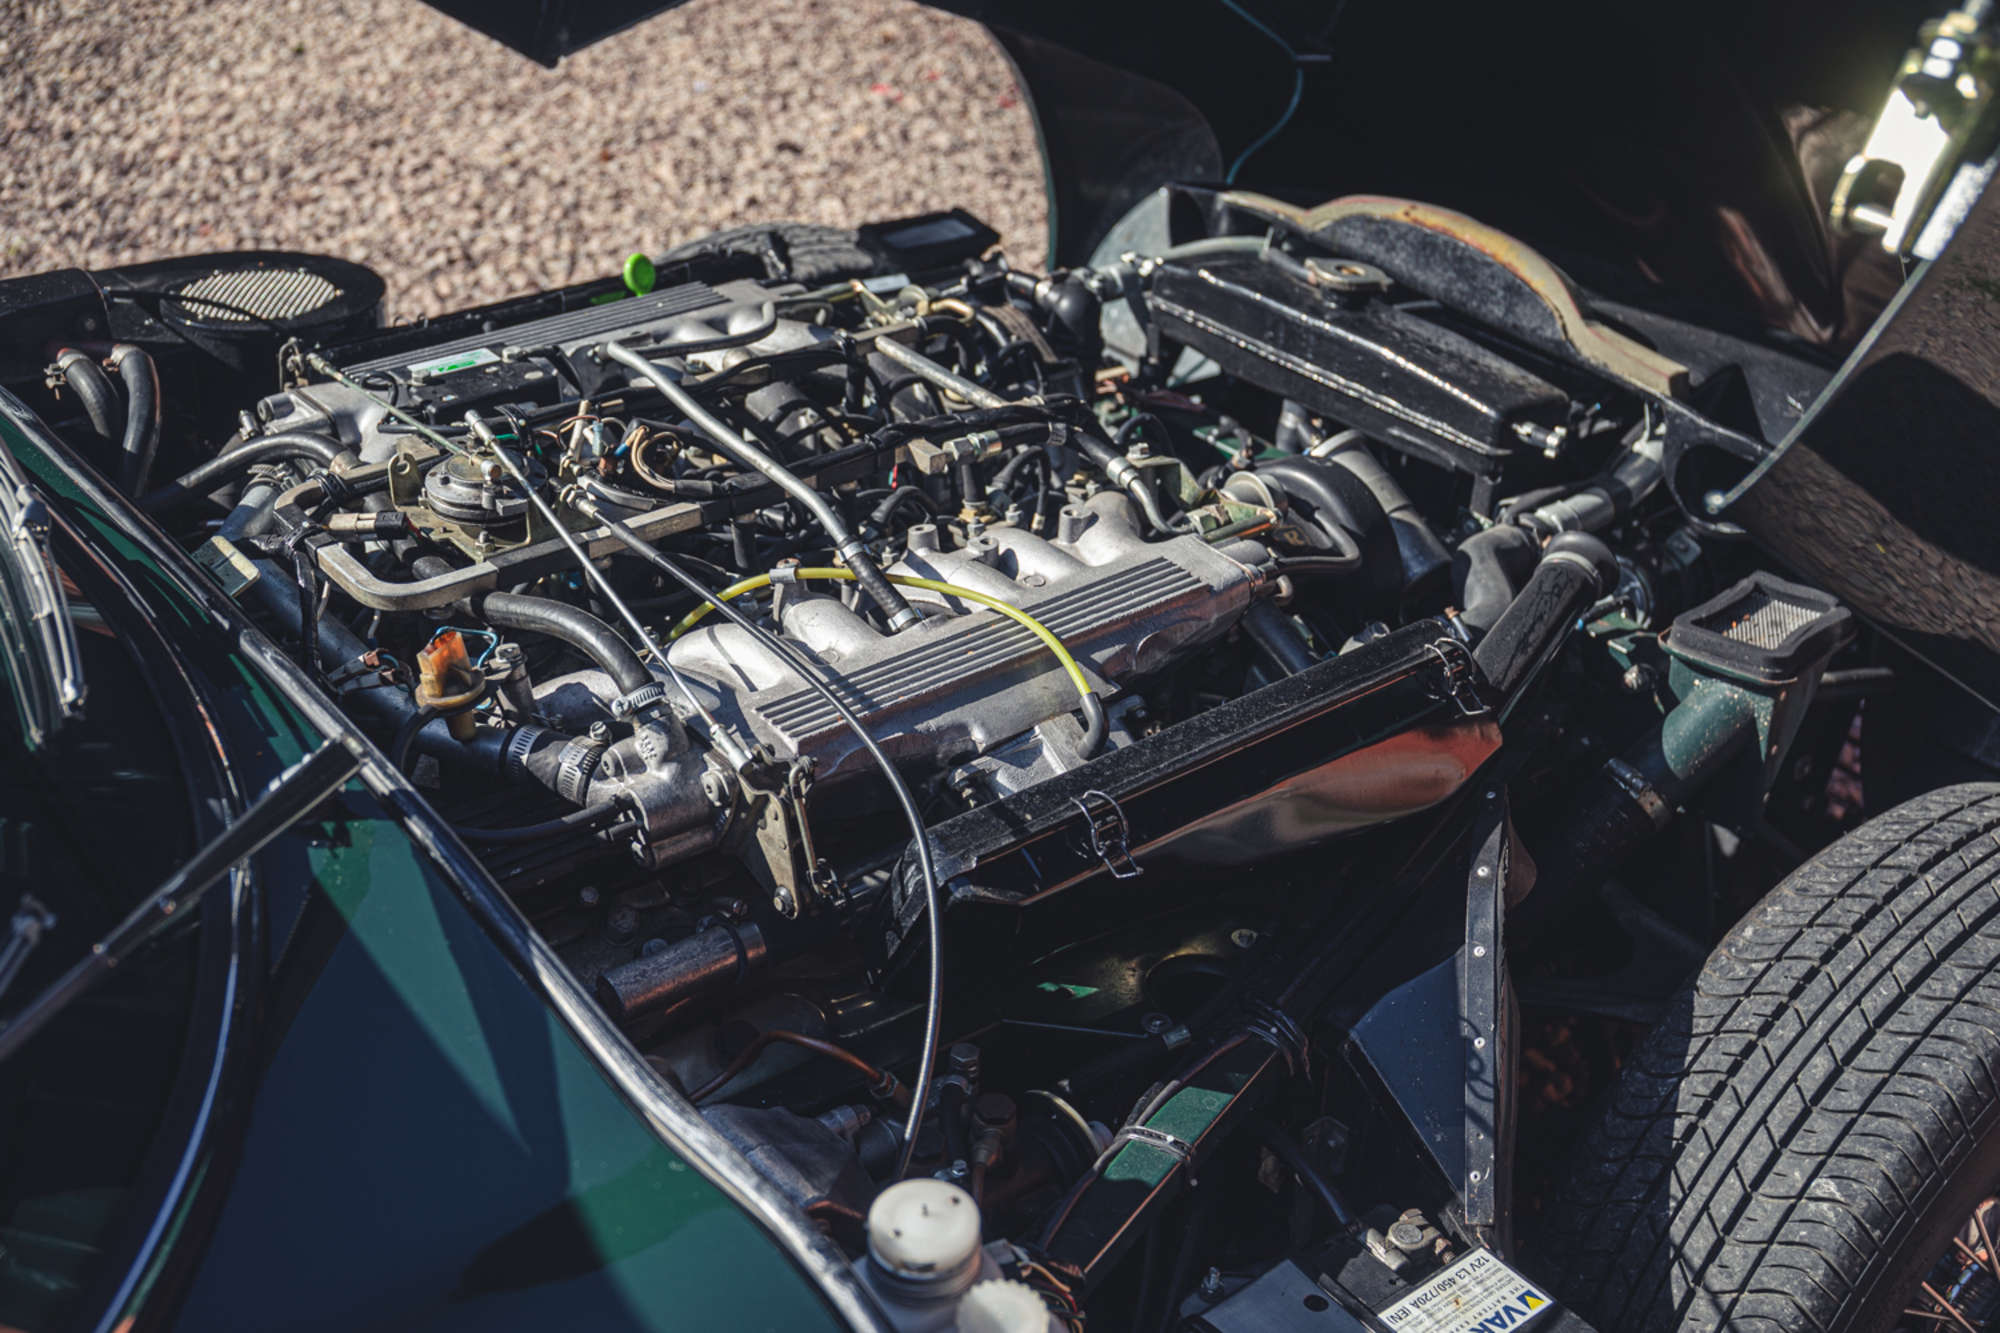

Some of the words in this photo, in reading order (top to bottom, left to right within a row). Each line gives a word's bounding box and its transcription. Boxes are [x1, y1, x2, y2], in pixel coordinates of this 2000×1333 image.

[1470, 1256, 1490, 1272] 12V
[1455, 1267, 1471, 1280] L3
[1409, 1277, 1456, 1309] 450/720A
[1386, 1306, 1412, 1324] (EN)
